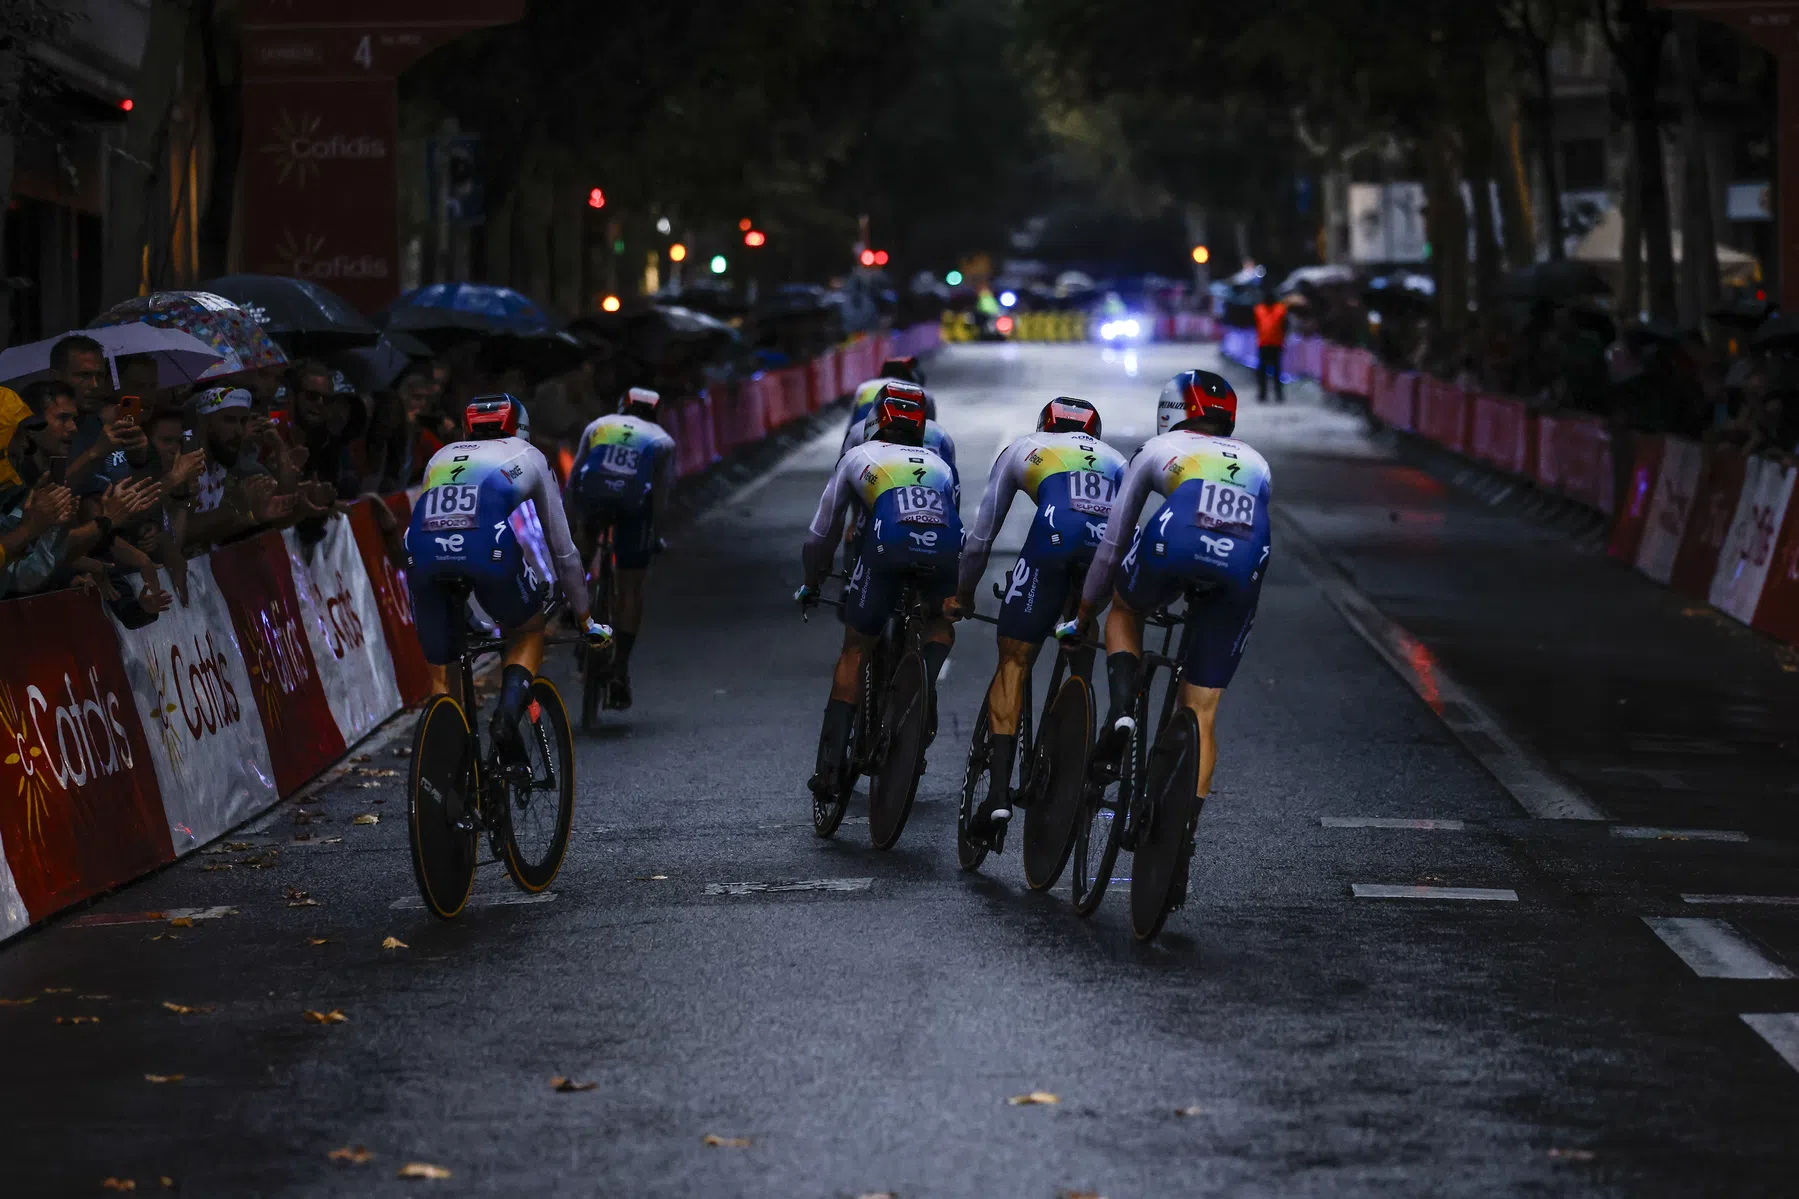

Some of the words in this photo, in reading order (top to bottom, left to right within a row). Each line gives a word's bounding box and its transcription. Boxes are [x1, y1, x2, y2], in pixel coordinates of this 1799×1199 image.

[353, 33, 373, 70] 4
[291, 134, 387, 160] Cofidis
[293, 255, 389, 279] Cofidis
[606, 445, 639, 470] 183
[428, 486, 476, 515] 185
[898, 487, 943, 512] 182
[1070, 471, 1115, 502] 187
[1205, 484, 1253, 523] 188
[1023, 567, 1040, 614] TotalEnergies
